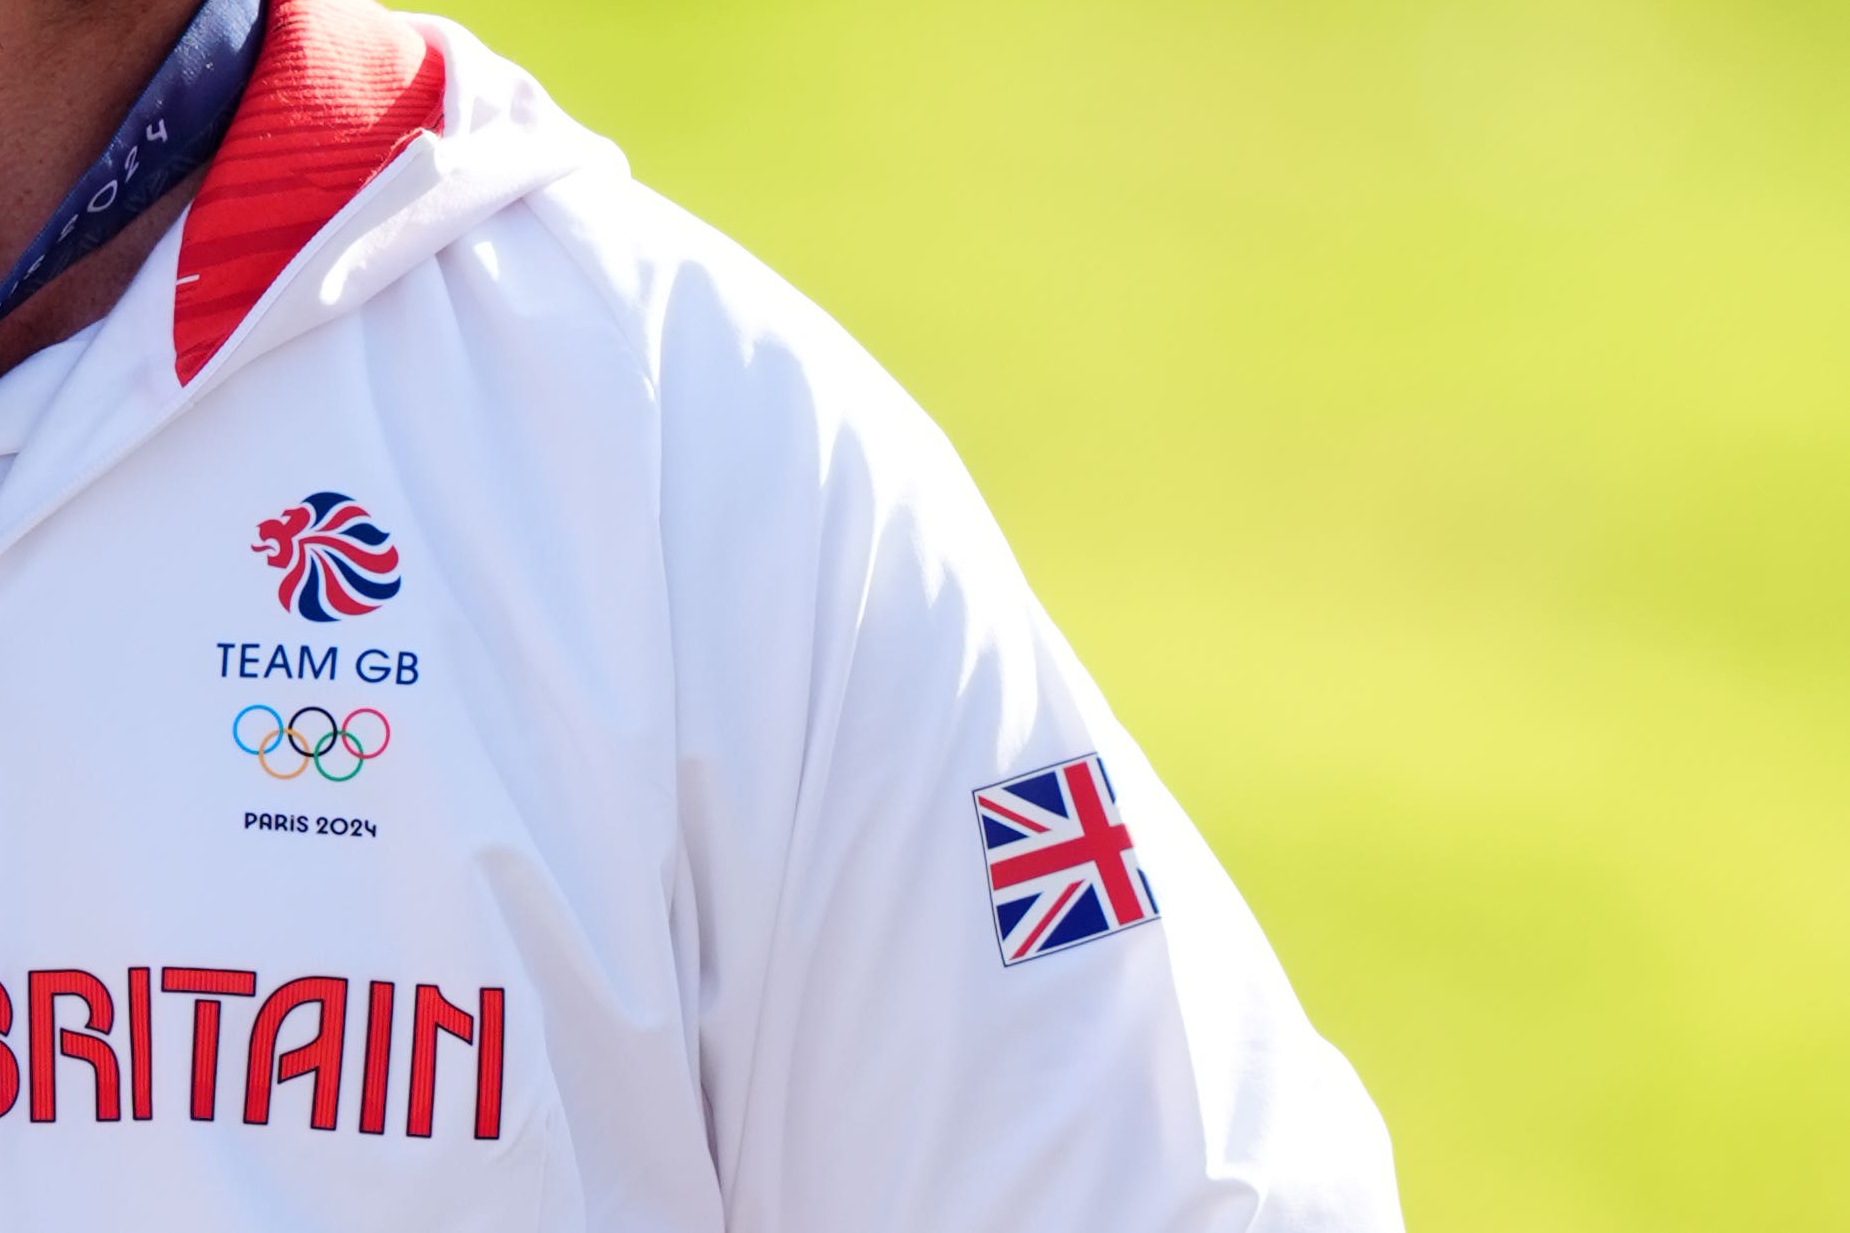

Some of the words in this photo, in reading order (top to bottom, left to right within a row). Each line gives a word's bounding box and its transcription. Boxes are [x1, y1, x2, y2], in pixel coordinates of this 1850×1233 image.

[216, 642, 338, 681] TEAM
[354, 649, 420, 685] GB
[316, 816, 377, 838] 2024
